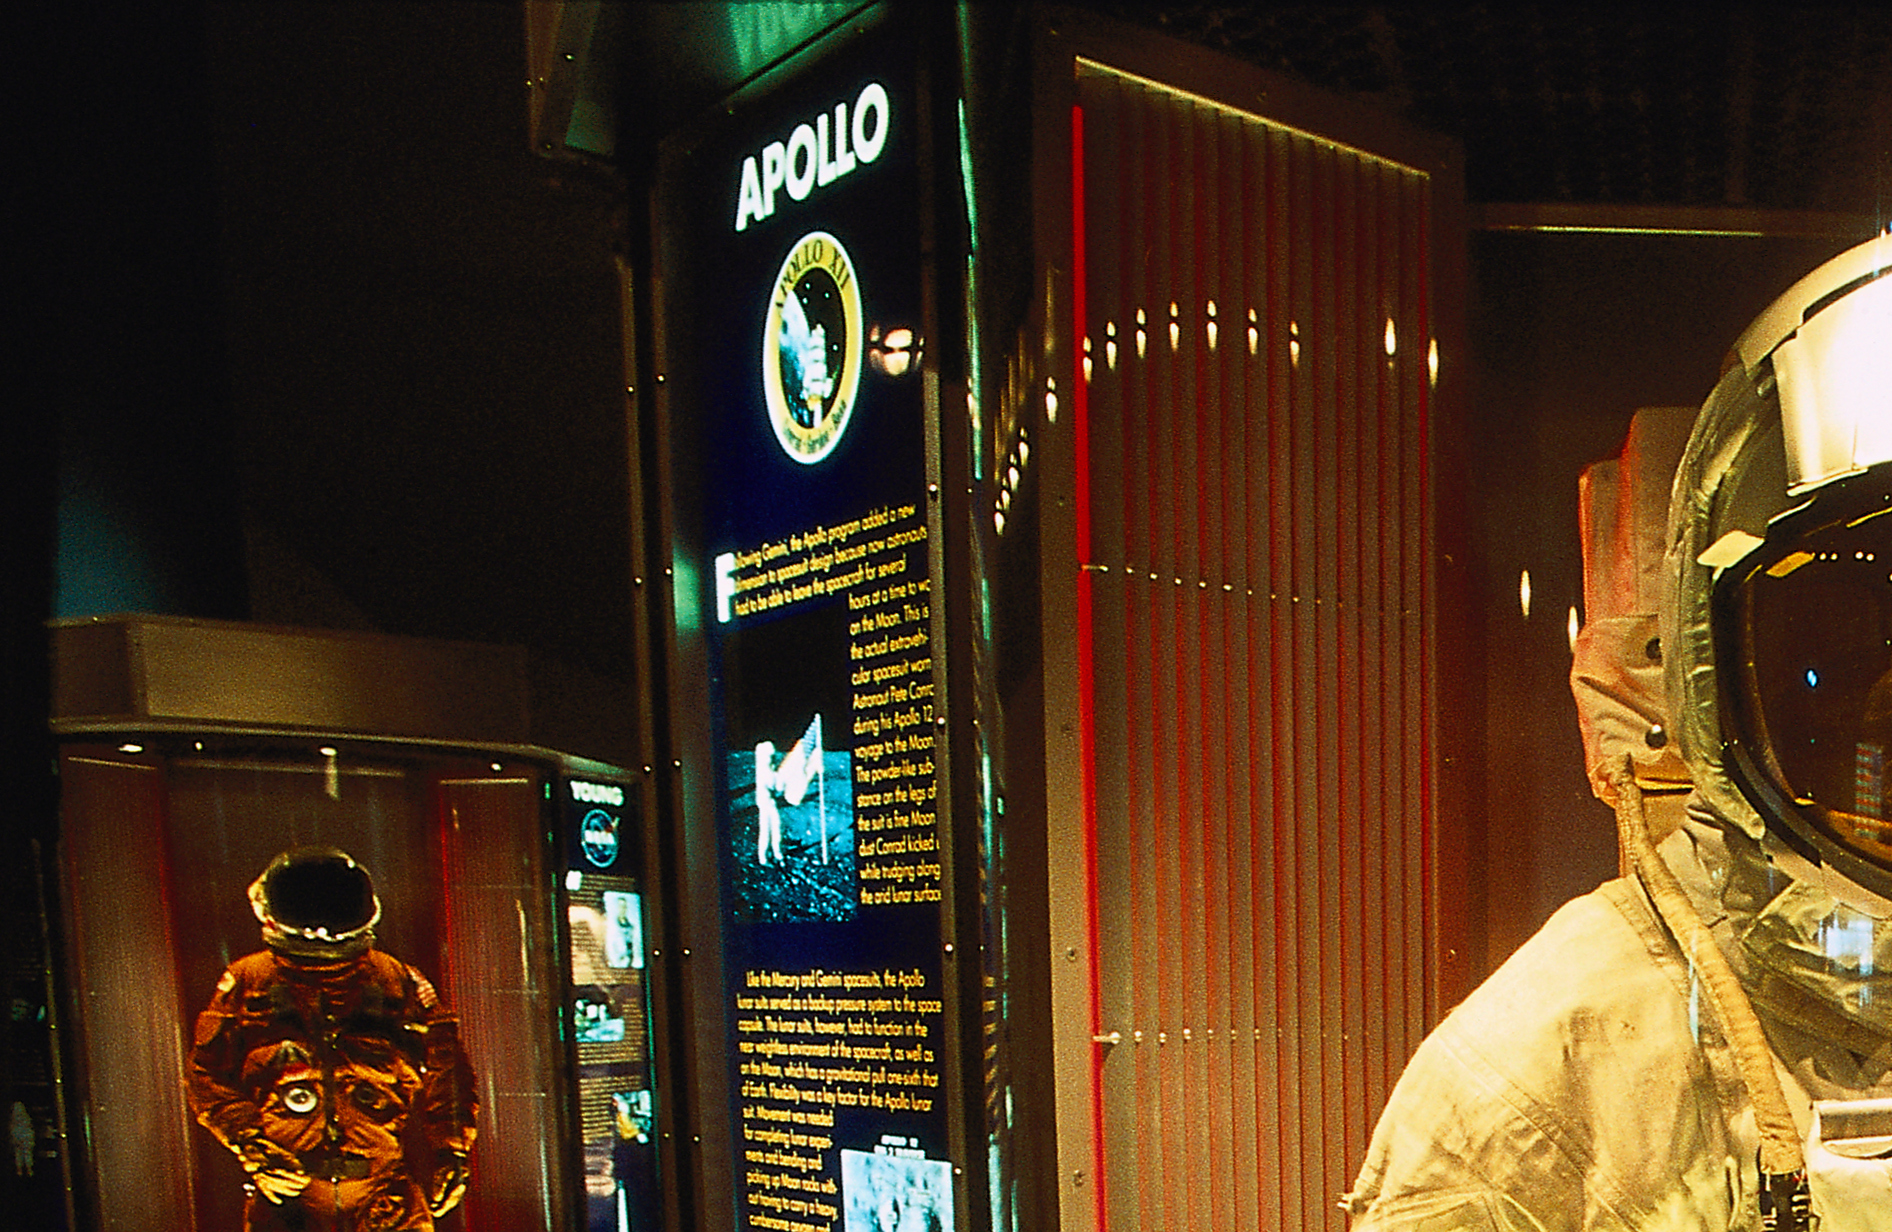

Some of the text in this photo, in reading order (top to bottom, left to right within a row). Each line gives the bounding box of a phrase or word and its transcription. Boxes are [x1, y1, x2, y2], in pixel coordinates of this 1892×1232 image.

[736, 82, 890, 232] APOLLO
[803, 526, 827, 550] Apollo
[898, 506, 914, 518] new
[868, 541, 884, 553] now
[887, 526, 927, 548] astronauts
[865, 563, 876, 580] for
[878, 554, 906, 577] several
[849, 593, 870, 609] hours
[872, 591, 880, 604] at
[882, 590, 887, 602] a
[889, 585, 906, 599] time
[908, 582, 916, 595] to
[850, 622, 860, 635] on
[862, 615, 874, 631] the
[903, 605, 920, 621] This
[923, 607, 928, 618] is
[850, 643, 863, 659] the
[865, 635, 888, 657] actual
[873, 660, 909, 685] spacesuit
[911, 658, 931, 672] worn
[853, 691, 889, 709] Astronaut
[890, 686, 907, 702] Pete
[854, 705, 933, 736] during his Apollo 12
[855, 744, 884, 761] voyage
[885, 741, 893, 754] to
[894, 736, 907, 752] the
[856, 766, 870, 782] The
[918, 757, 935, 775] sub-
[570, 780, 624, 806] YOUNG
[857, 781, 937, 807] stance on the legs of
[857, 810, 935, 831] the suit is fine Moon
[859, 833, 934, 856] dust Conrad kicked
[860, 860, 941, 883] while trudging along
[860, 887, 873, 904] the
[874, 886, 891, 904] arid
[892, 886, 912, 903] lunar
